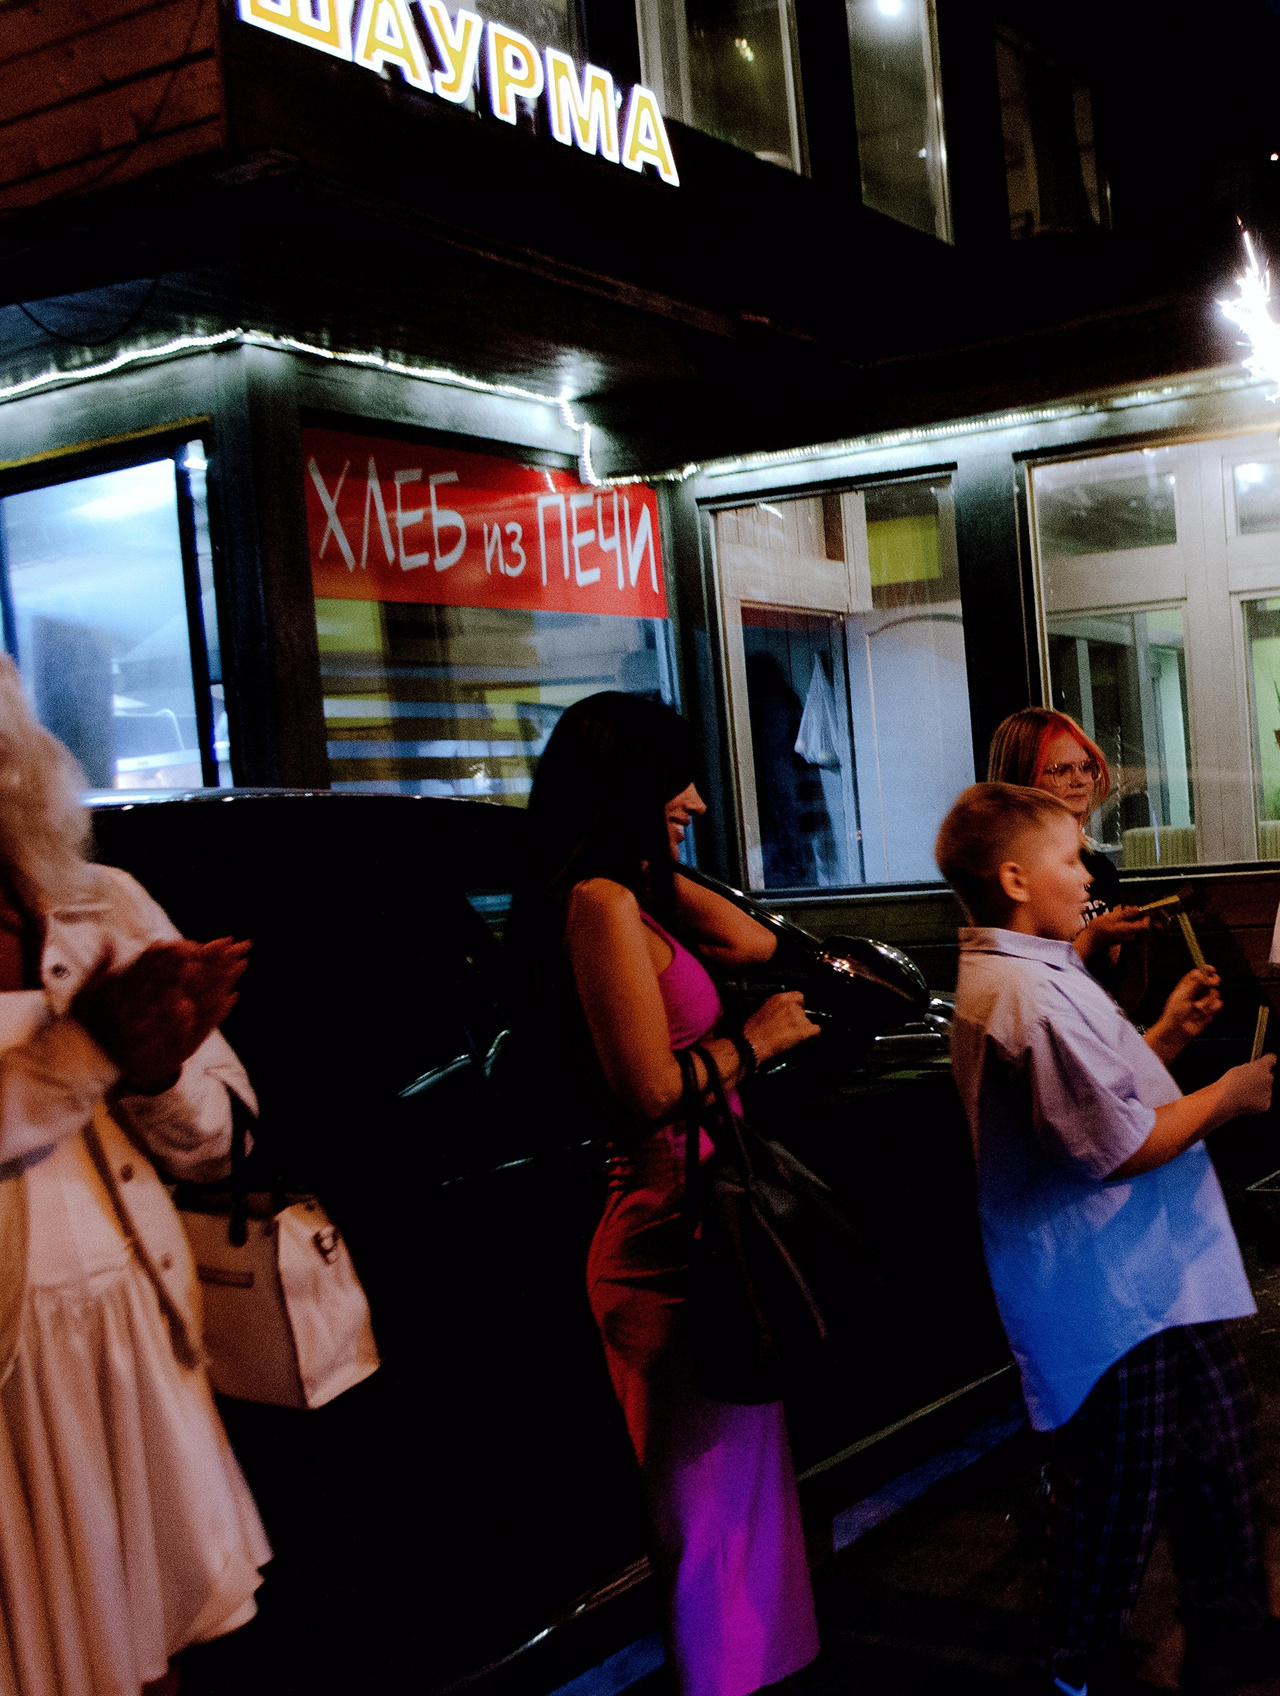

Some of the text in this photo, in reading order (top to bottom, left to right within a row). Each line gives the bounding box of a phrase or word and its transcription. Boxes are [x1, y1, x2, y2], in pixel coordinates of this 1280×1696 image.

[307, 455, 660, 595] ХЛЕБ из ПЕЧИ
